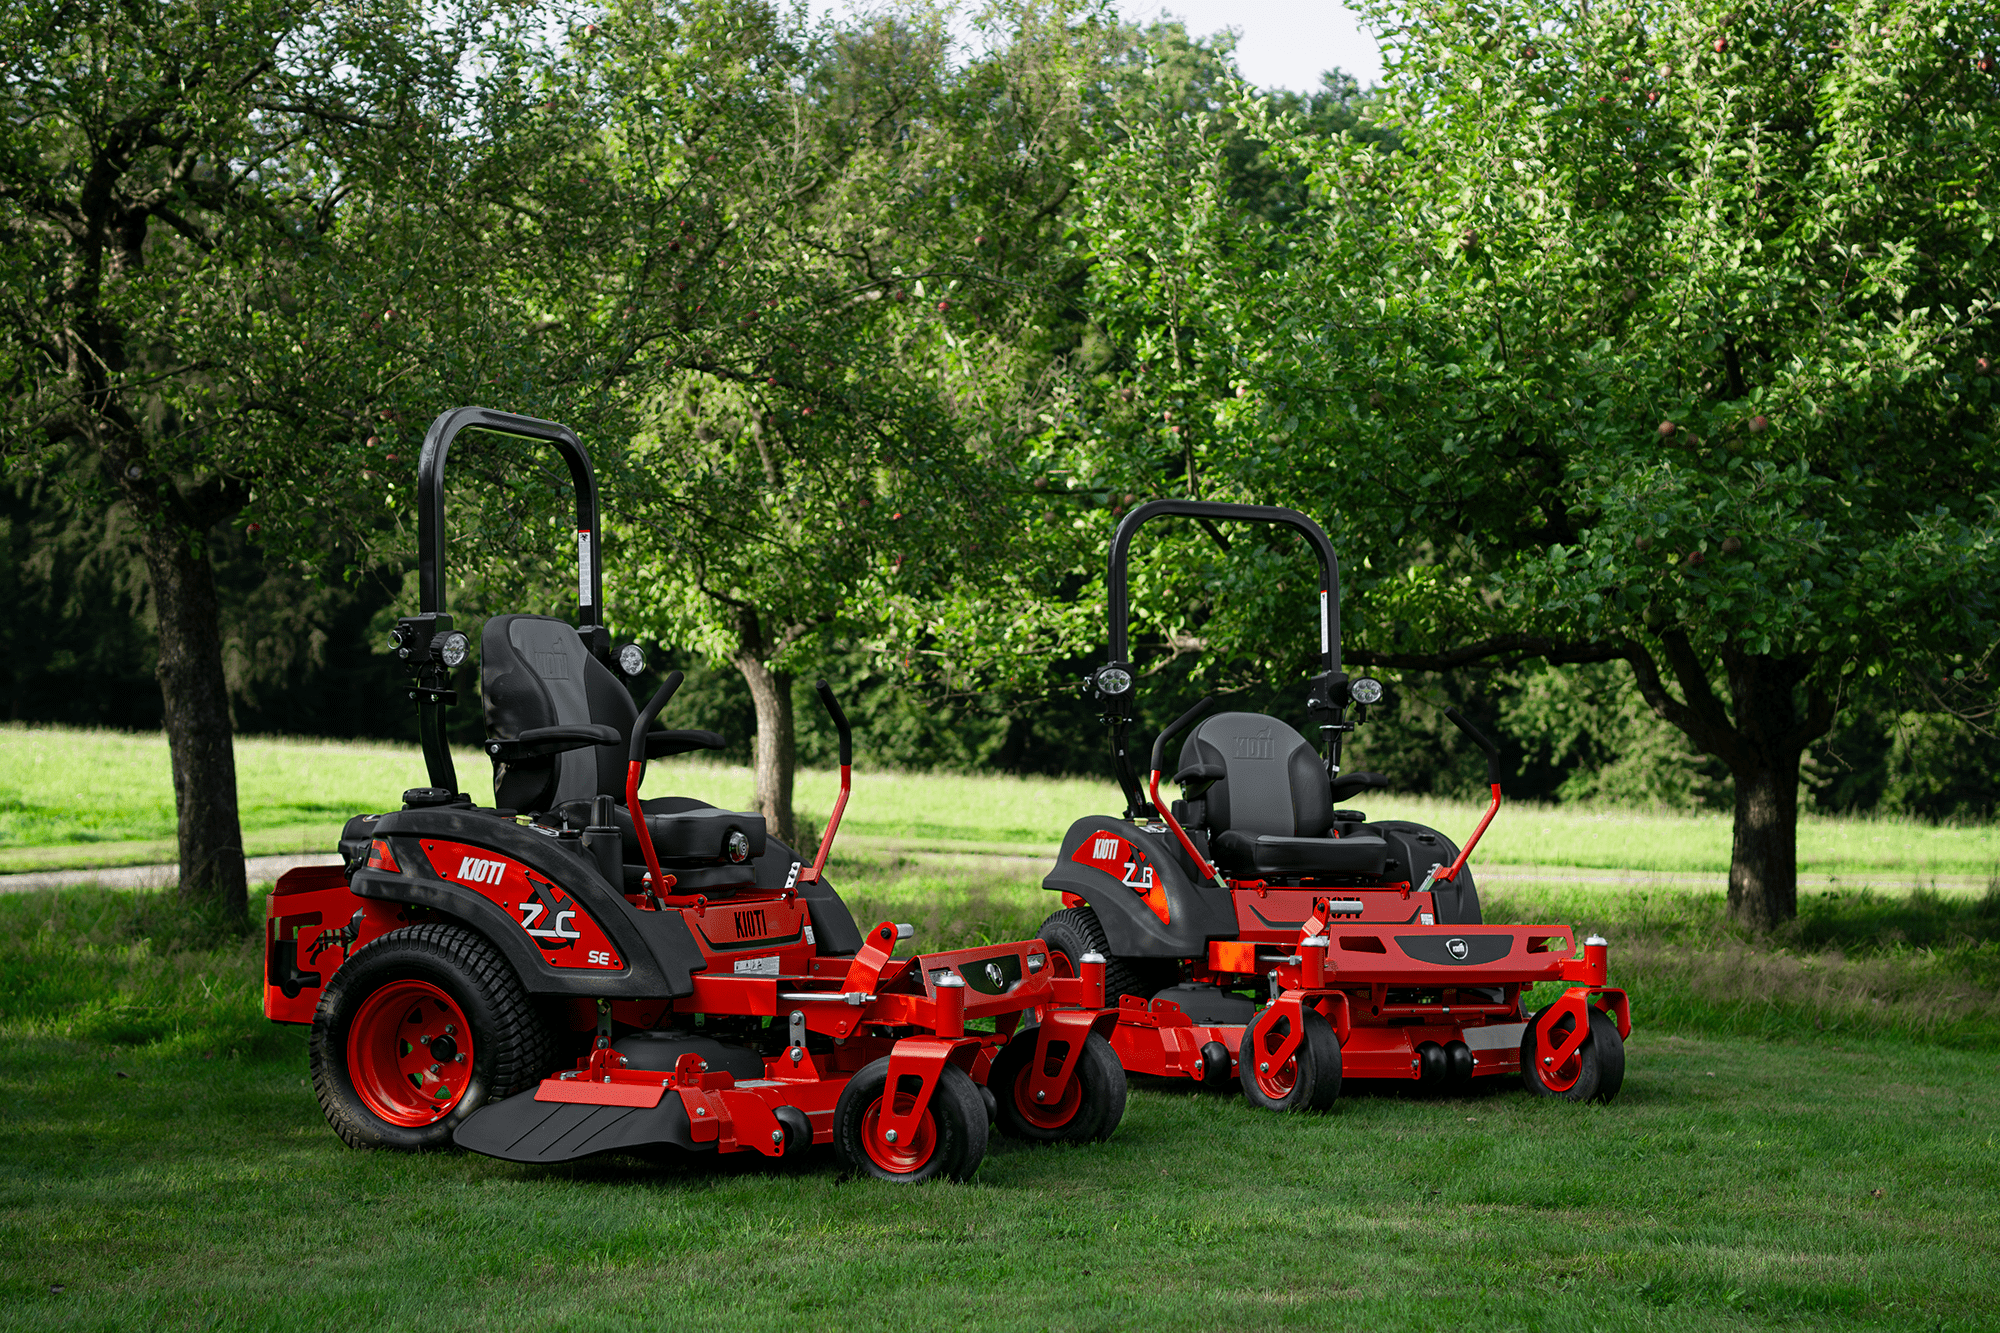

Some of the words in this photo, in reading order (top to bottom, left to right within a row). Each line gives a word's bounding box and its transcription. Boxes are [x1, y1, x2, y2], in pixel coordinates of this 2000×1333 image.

[1092, 838, 1119, 860] KIOTI
[457, 856, 507, 886] KIOTI
[734, 909, 767, 939] KIOTI
[587, 950, 610, 966] SE
